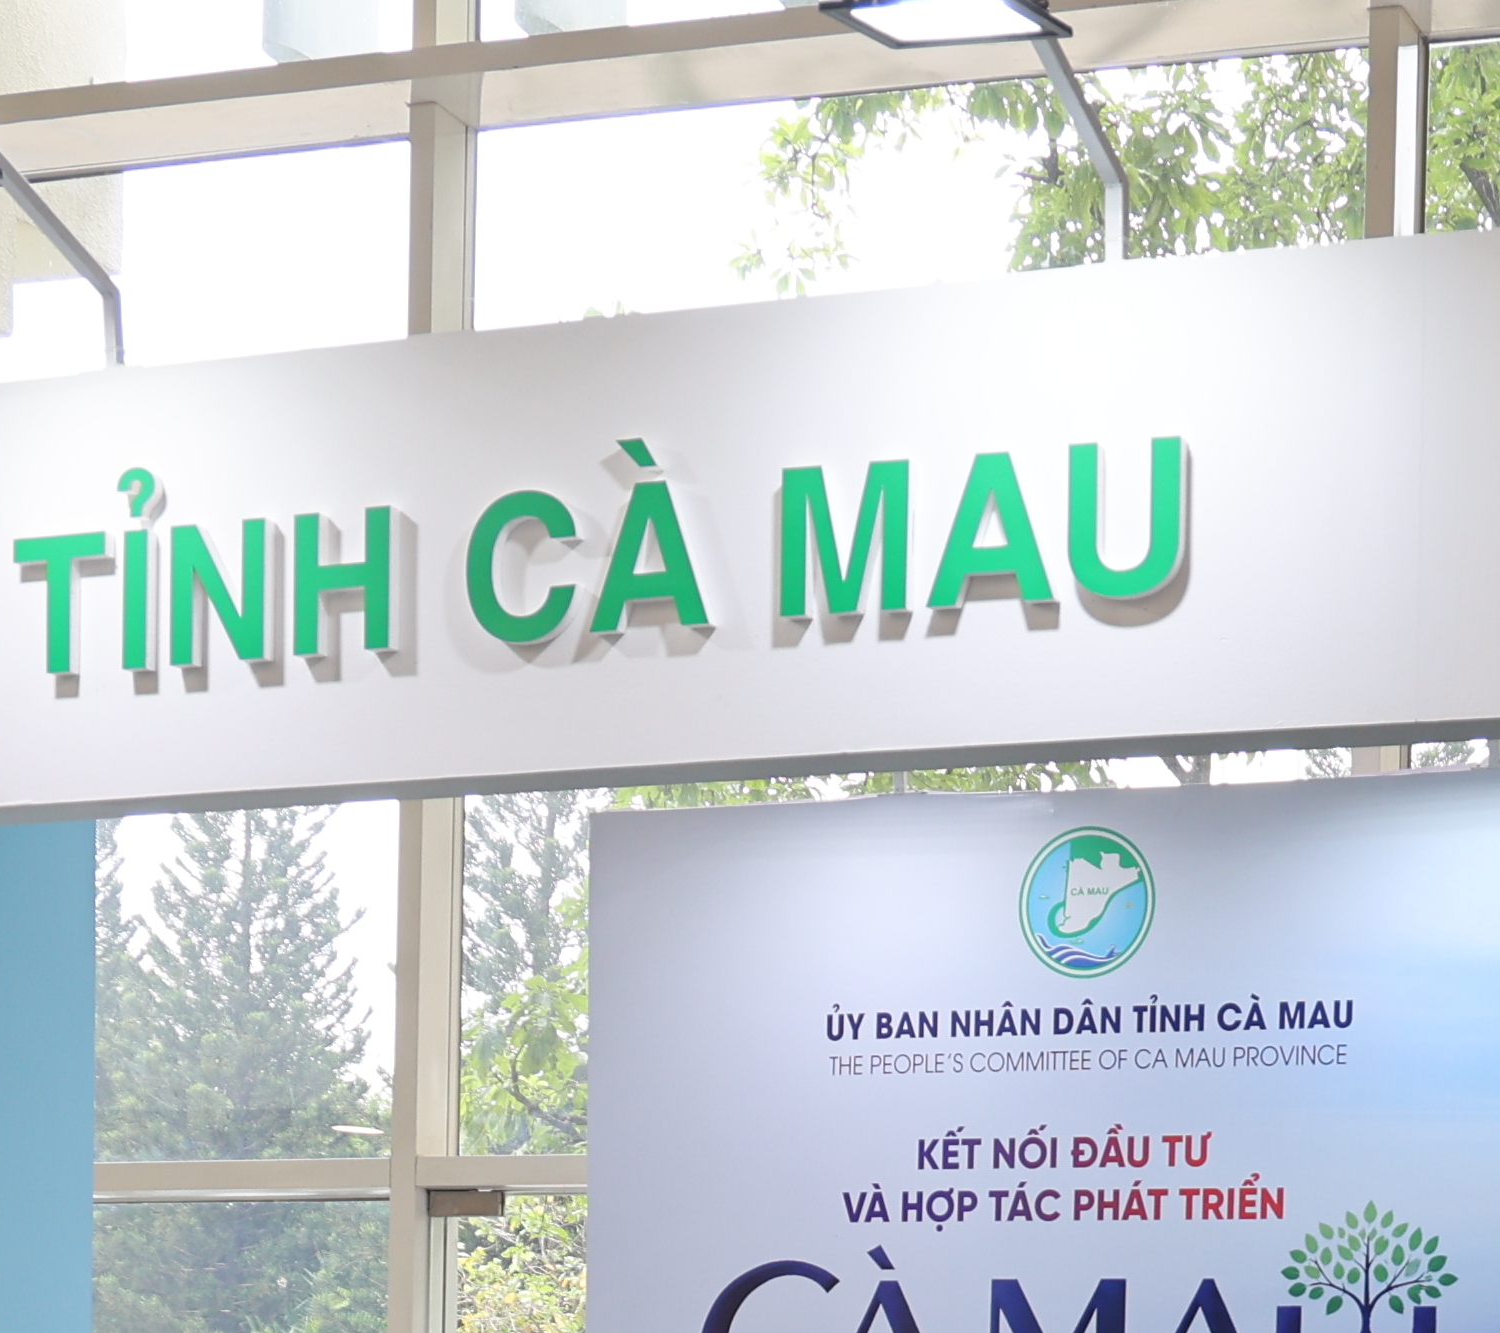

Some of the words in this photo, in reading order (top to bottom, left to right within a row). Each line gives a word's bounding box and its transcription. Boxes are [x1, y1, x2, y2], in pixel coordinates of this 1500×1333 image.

[12, 466, 402, 677] TỈNH
[464, 437, 713, 646] CÀ
[779, 435, 1188, 622] MAU
[1087, 887, 1109, 896] MAU
[827, 1003, 865, 1041] ỦY
[876, 1010, 938, 1039] BAN
[951, 1000, 1041, 1038] NHÂN
[1054, 998, 1122, 1036] DÂN
[1133, 994, 1205, 1034] TỈNH
[1217, 994, 1267, 1031] CÀ
[1279, 999, 1354, 1030] MAU
[830, 1054, 863, 1076] THE
[970, 1049, 1091, 1073] COMMITTEE
[1099, 1048, 1128, 1071] OF
[1134, 1047, 1167, 1070] CA
[1175, 1045, 1226, 1068] MAU
[1233, 1043, 1347, 1067] PROVINCE
[918, 1126, 981, 1171] KẾT
[994, 1124, 1058, 1169] NỐI
[1071, 1123, 1150, 1168] ĐẦU
[1162, 1131, 1213, 1168] TƯ
[842, 1183, 890, 1223] VÀ
[901, 1187, 978, 1232] HỢP
[988, 1181, 1061, 1222] TÁC
[1074, 1180, 1168, 1221] PHÁT
[1179, 1172, 1285, 1220] TRIỂN
